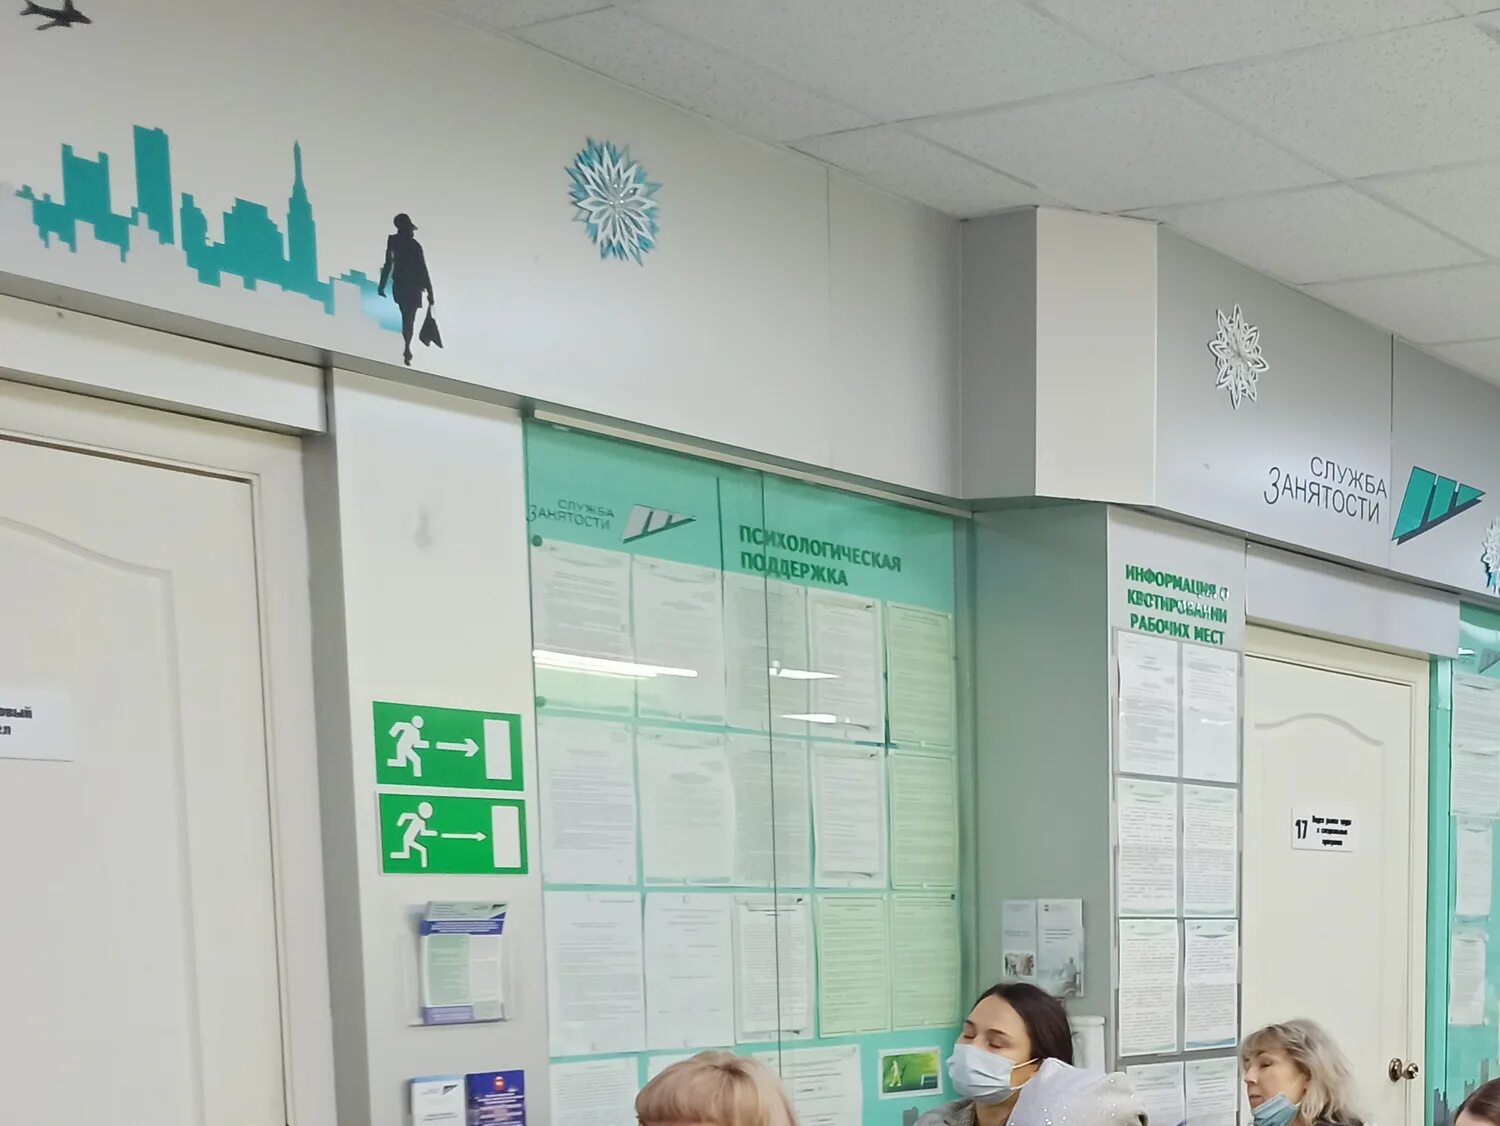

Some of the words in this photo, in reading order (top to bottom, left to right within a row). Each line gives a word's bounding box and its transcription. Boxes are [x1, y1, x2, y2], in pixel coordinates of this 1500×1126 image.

[1263, 466, 1380, 524] ЗАНЯТОСТИ
[1310, 456, 1388, 498] СЛУЖБА
[558, 499, 615, 518] СЛУЖБА
[739, 524, 902, 573] ПСИХОЛОГИЧЕСКАЯ
[741, 551, 849, 587] ПОДДЕРЖКА
[1125, 563, 1217, 599] ИНФОРМАЦИЯ
[1130, 612, 1190, 640] РАБОЧИХ
[1194, 625, 1226, 646] МЕСТ
[1295, 819, 1308, 840] 17
